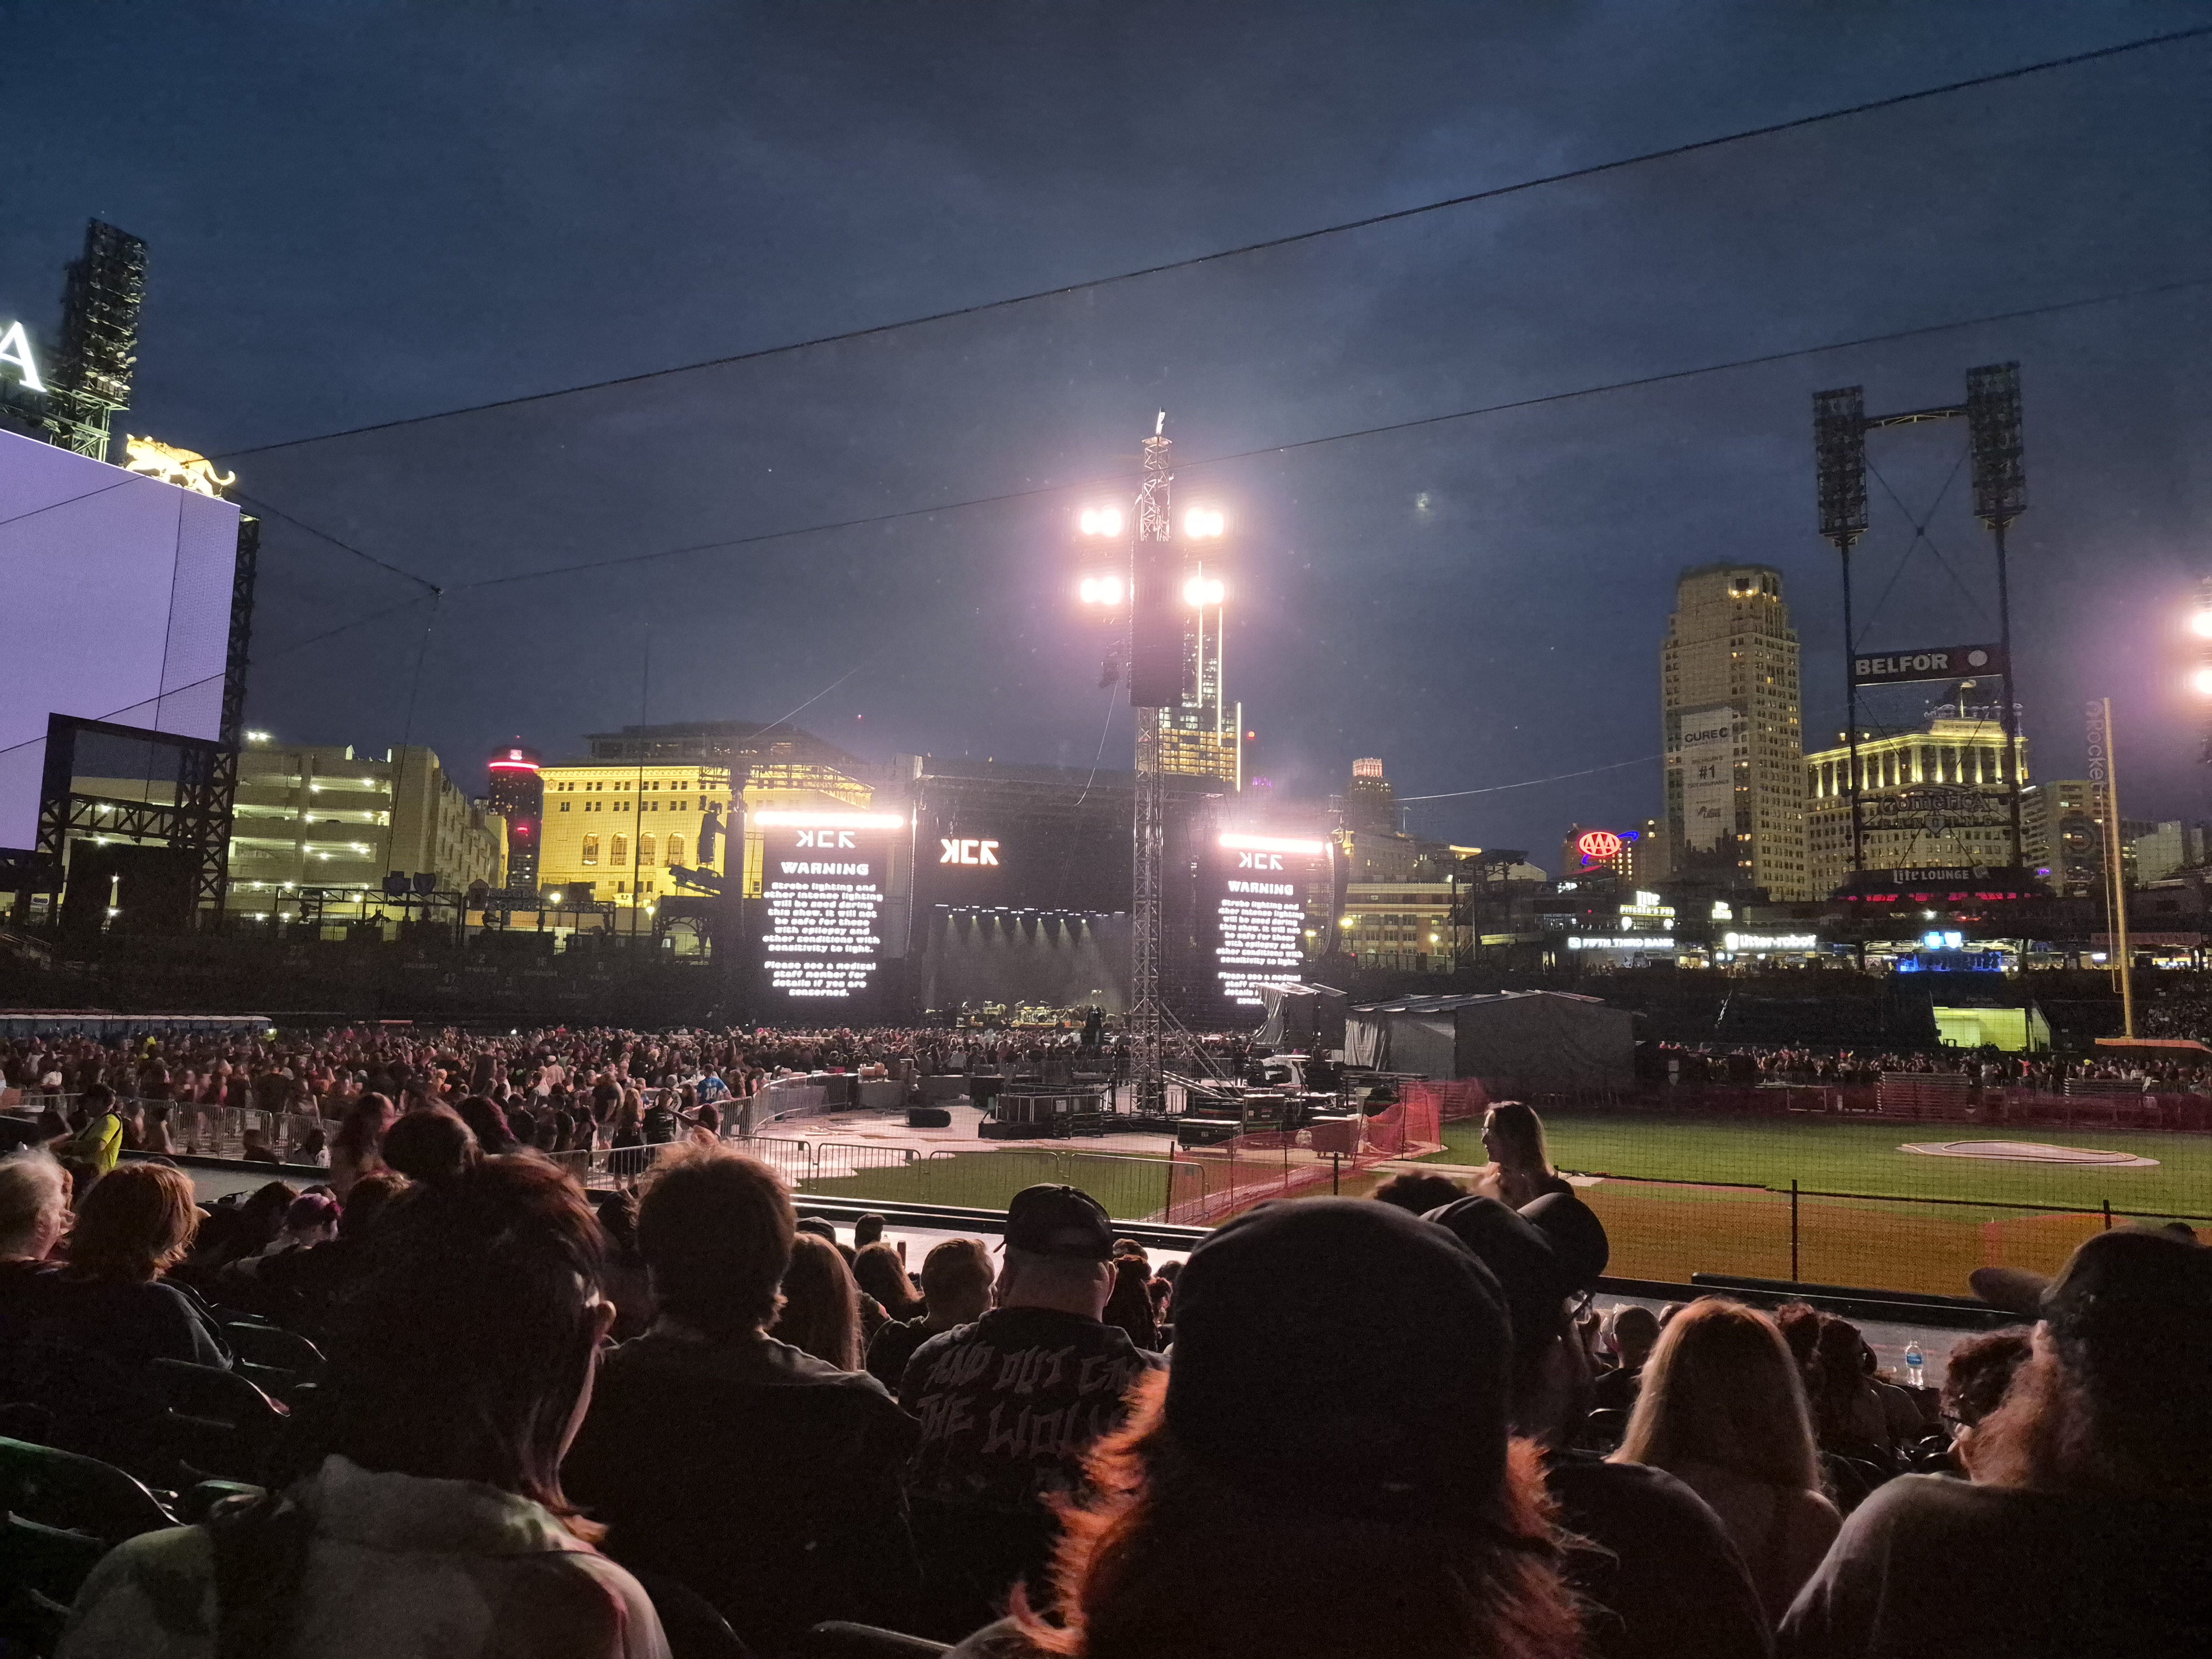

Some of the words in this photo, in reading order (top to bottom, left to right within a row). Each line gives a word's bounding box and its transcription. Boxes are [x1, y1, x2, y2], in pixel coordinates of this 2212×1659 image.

[1855, 653, 1948, 676] BELFOR
[1685, 729, 1718, 742] CURE
[2086, 719, 2107, 789] Rocket
[1699, 764, 1715, 780] #1
[1584, 832, 1616, 855] AAA
[781, 862, 869, 875] WARNING
[1893, 869, 1919, 884] Lite
[1921, 870, 1969, 880] LOUNGE
[812, 883, 853, 892] lighting
[1228, 880, 1293, 895] WARNING
[842, 892, 883, 902] lighting
[839, 901, 873, 910] during
[1222, 899, 1250, 907] Strobe
[1251, 901, 1282, 910] lighting
[768, 908, 790, 916] this
[1274, 910, 1305, 920] lighting
[775, 917, 789, 925] be
[791, 917, 816, 926] safe
[818, 917, 836, 926] for
[1272, 919, 1298, 927] during
[802, 927, 847, 936] epilepsy
[762, 934, 795, 942] other
[1583, 938, 1611, 947] FIFTH
[1613, 938, 1644, 947] THIRD
[1644, 938, 1674, 947] BANK
[768, 944, 828, 953] sensitivity
[845, 945, 874, 953] light.
[764, 961, 801, 969] Please
[836, 962, 876, 971] medical
[774, 970, 803, 978] staff
[773, 979, 811, 987] details
[924, 1340, 995, 1392] AND
[993, 1345, 1076, 1394] OUT
[916, 1392, 976, 1452] THE
